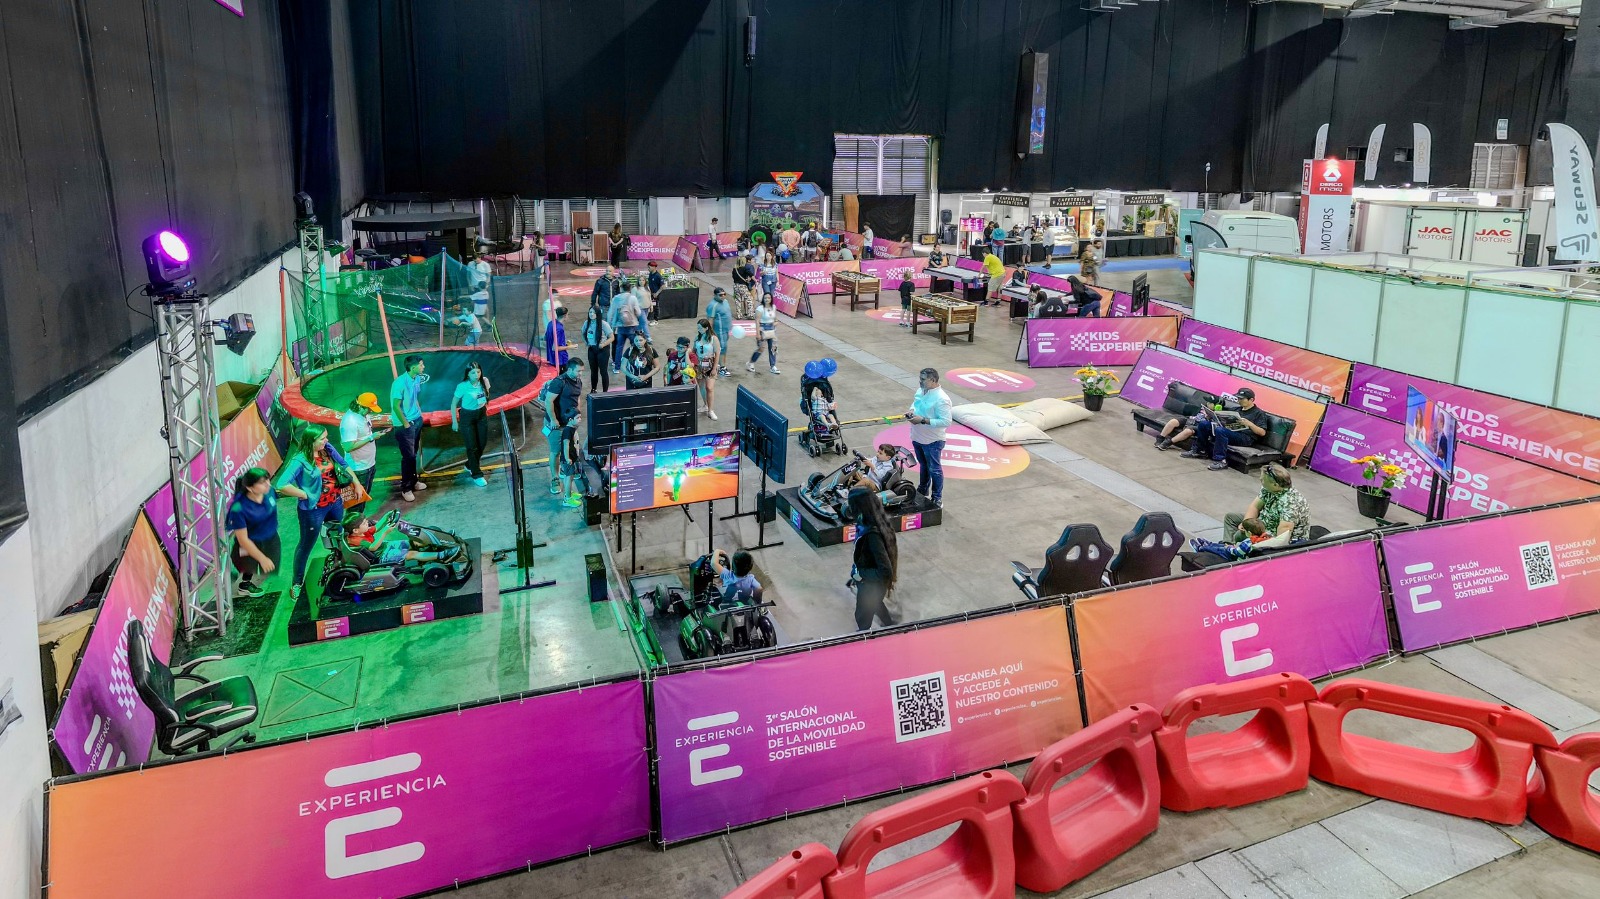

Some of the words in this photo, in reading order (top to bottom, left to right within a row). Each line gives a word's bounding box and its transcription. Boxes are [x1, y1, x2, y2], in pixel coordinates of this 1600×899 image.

[1320, 207, 1334, 251] MOTORS
[1418, 226, 1453, 234] JAC
[1475, 229, 1512, 237] JAC
[1474, 236, 1512, 244] MOTORS
[1089, 331, 1120, 341] KIDS
[1240, 348, 1274, 367] KIDS
[1238, 360, 1332, 394] EXPERIENCE
[1358, 386, 1397, 400] EXPERIENCIA
[1445, 402, 1499, 428] KIDS
[1329, 431, 1371, 450] EXPERIENCIA
[1455, 421, 1600, 473] XPERIENCE
[1554, 541, 1582, 552] ESCANEA
[1561, 550, 1585, 559] ACCEDE
[1456, 560, 1480, 570] SALÓN
[1558, 558, 1586, 568] NUESTRO
[1400, 572, 1444, 586] EXPERIENCIA
[1450, 567, 1504, 581] INTERNACIONAL
[1453, 581, 1463, 590] DE
[1463, 580, 1473, 588] LA
[1472, 573, 1509, 587] MOVILIDAD
[1455, 585, 1494, 599] SOSTENIBLE
[1203, 600, 1279, 627] EXPERIENCIA
[952, 668, 998, 685] ESCANEA
[999, 660, 1024, 675] AQUÍ
[953, 688, 960, 696] Y
[962, 681, 1002, 695] ACCEDE
[1003, 678, 1011, 686] A
[955, 692, 1001, 708] NUESTRO
[1002, 679, 1059, 698] CONTENIDO
[765, 713, 779, 724] 3er
[779, 704, 818, 721] SALÓN
[767, 711, 857, 737] INTERNACIONAL
[675, 725, 754, 748] EXPERIENCIA
[768, 739, 784, 749] DE
[786, 735, 801, 746] LA
[803, 720, 866, 742] MOVILIDAD
[768, 738, 837, 762] SOSTENIBLE
[299, 774, 447, 817] EXPERIENCIA
